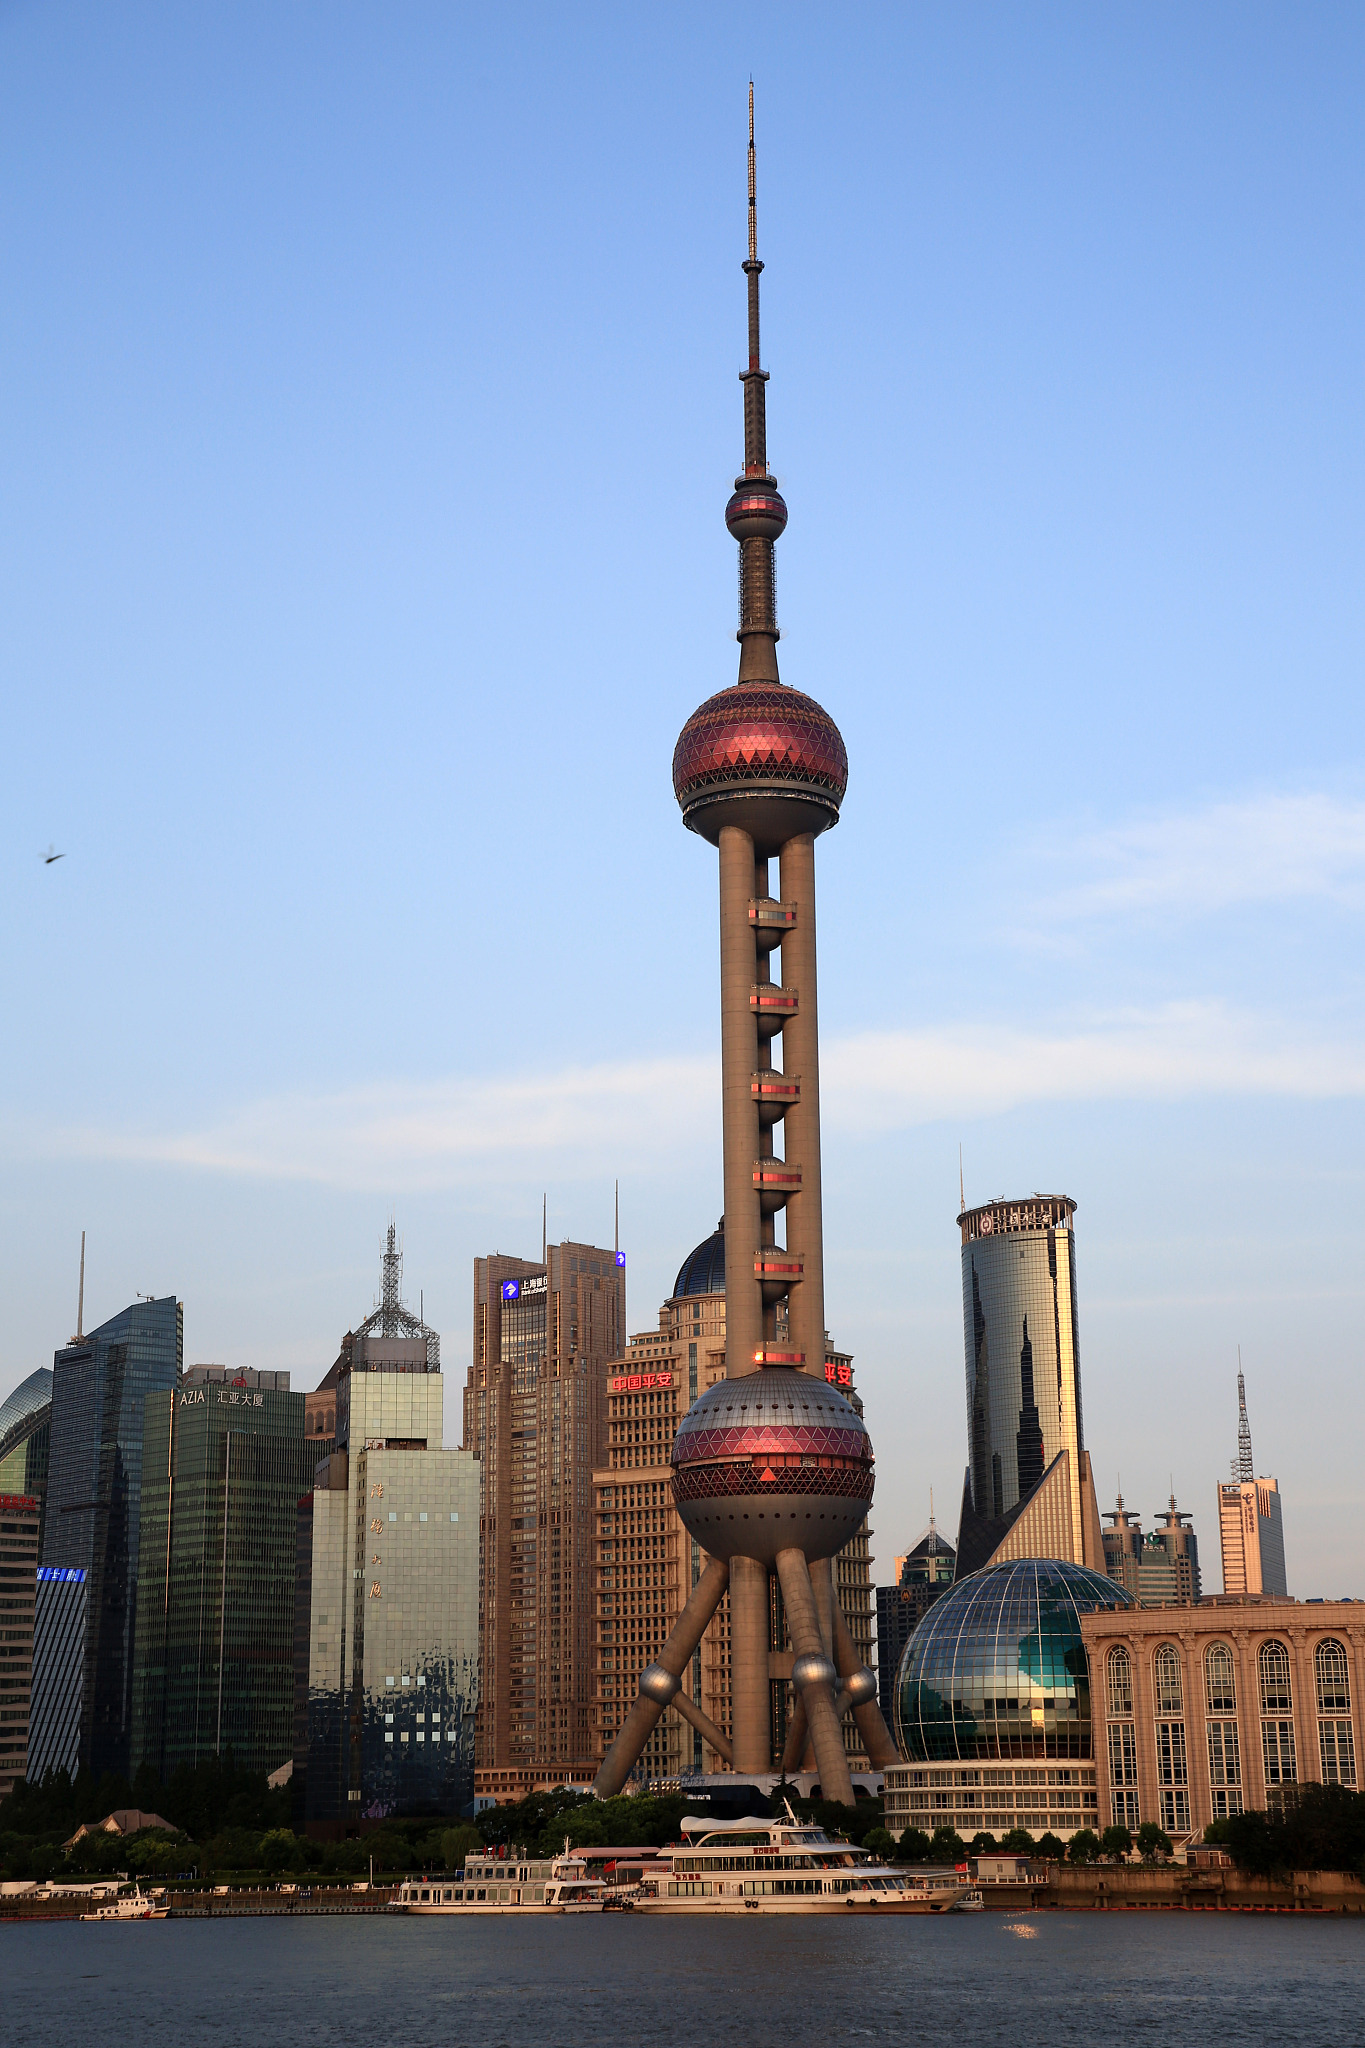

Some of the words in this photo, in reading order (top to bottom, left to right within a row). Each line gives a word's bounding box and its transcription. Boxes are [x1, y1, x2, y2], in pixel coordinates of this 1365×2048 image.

[612, 1371, 672, 1391] 中国平安
[824, 1362, 852, 1386] 平安
[180, 1389, 206, 1406] AZIA
[217, 1389, 264, 1408] 汇亚大厦
[0, 1494, 36, 1506] 信息中心
